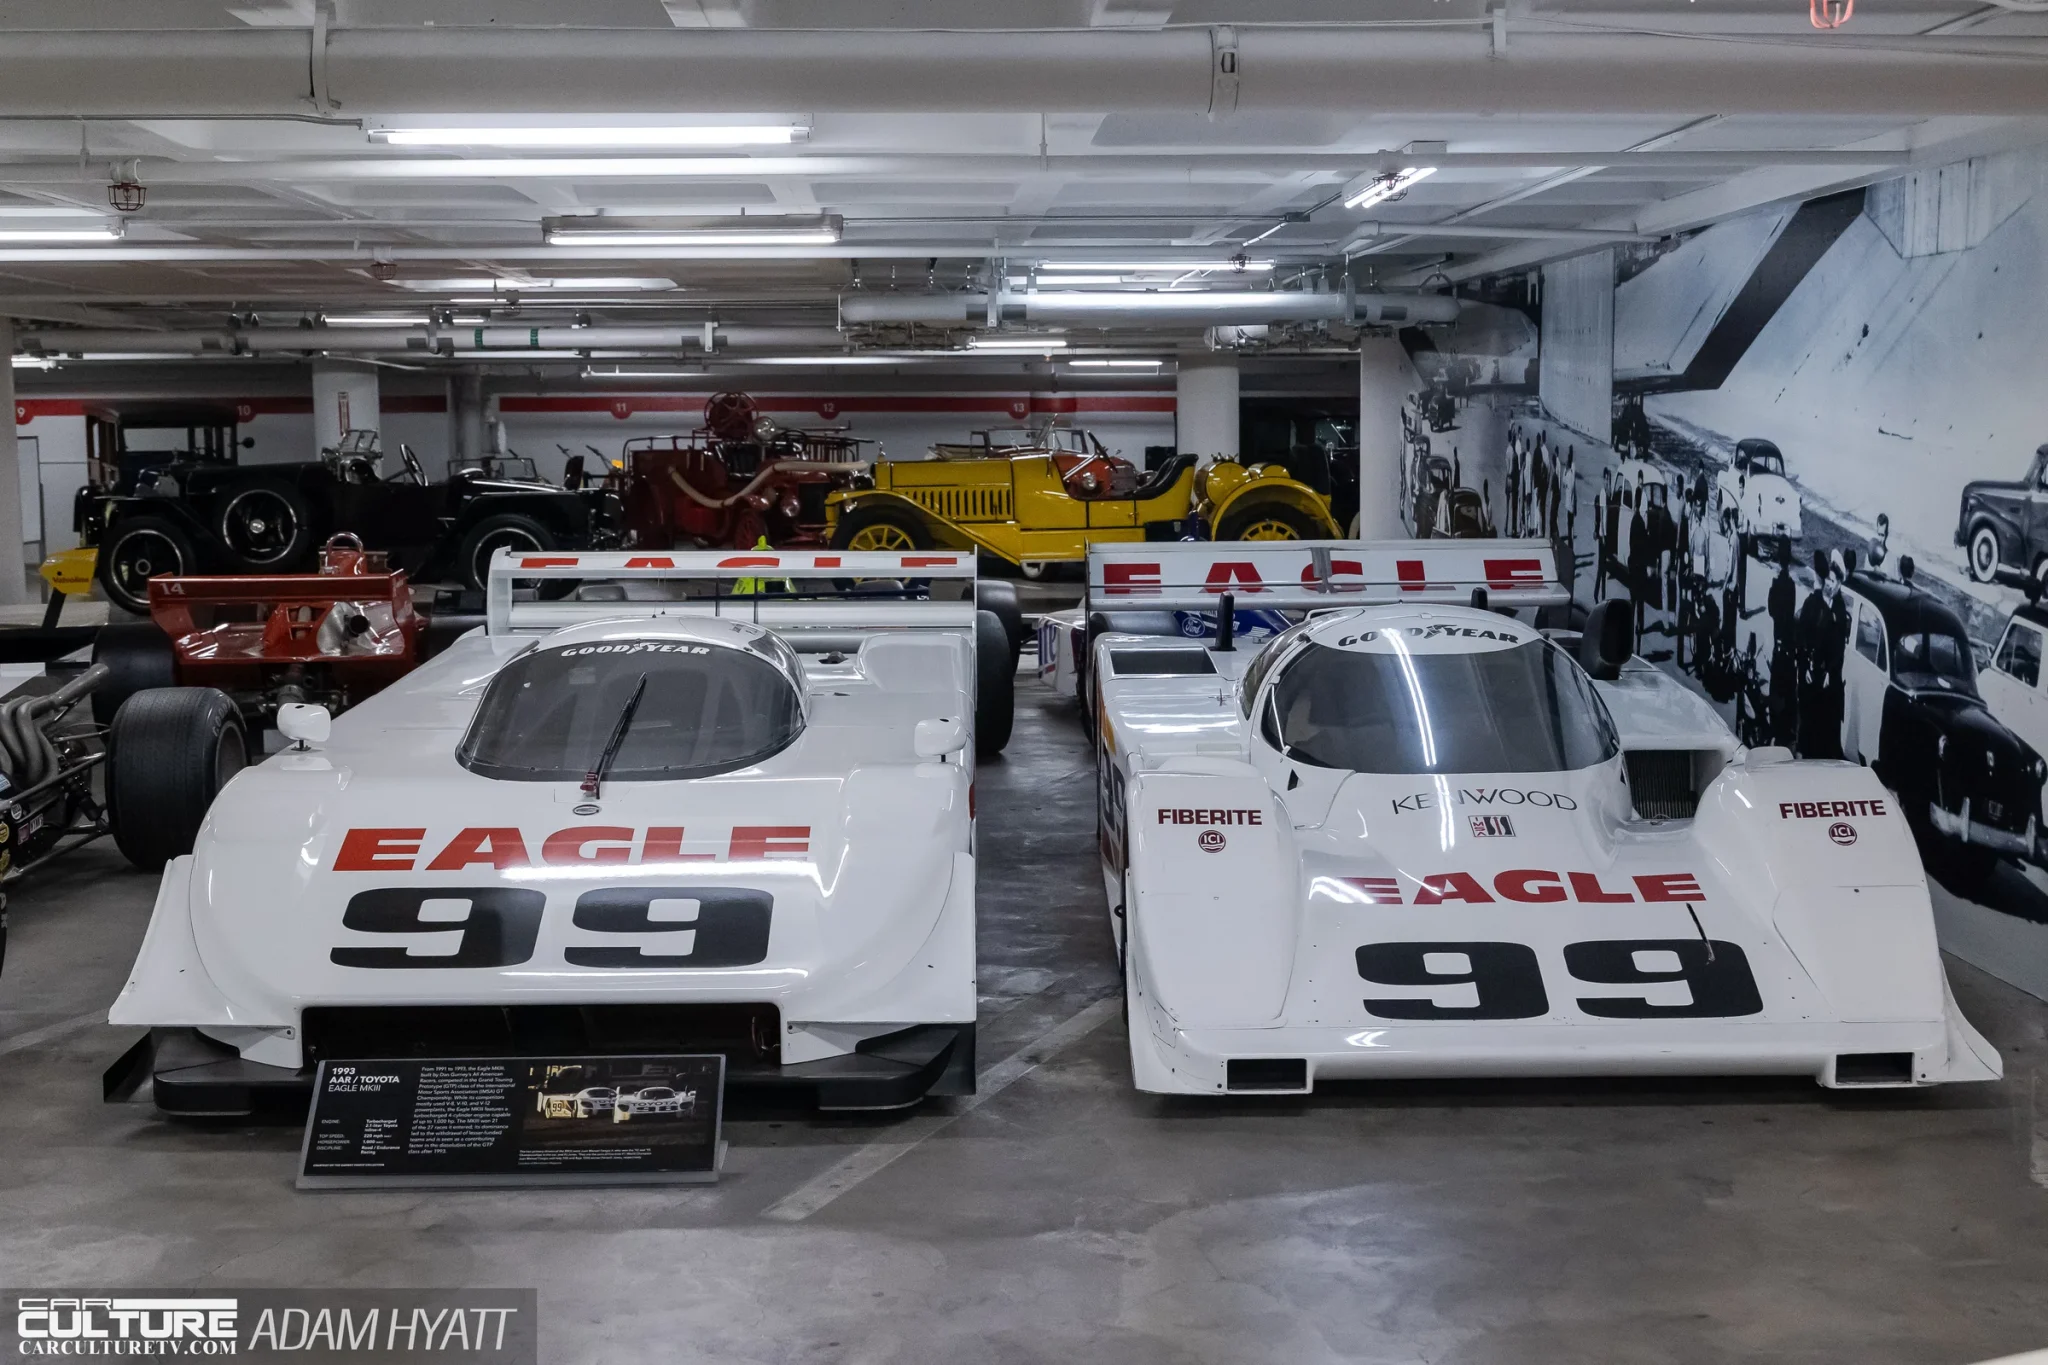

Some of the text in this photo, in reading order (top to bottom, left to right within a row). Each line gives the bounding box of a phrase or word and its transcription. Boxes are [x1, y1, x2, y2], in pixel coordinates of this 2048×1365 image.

[17, 407, 26, 418] 9
[238, 405, 251, 415] 10
[616, 403, 627, 412] 11
[823, 403, 835, 413] 12
[1012, 403, 1025, 413] 13
[160, 582, 185, 595] 14
[1185, 617, 1201, 634] Ford
[561, 641, 711, 657] GOODYEAR
[1779, 800, 1887, 819] FIBERITE
[1158, 809, 1262, 825] FIBERITE
[1833, 826, 1851, 836] ICI
[1203, 834, 1220, 844] ICI
[332, 826, 811, 871] EAGLE
[1338, 869, 1706, 905] EAGLE
[330, 886, 775, 969] 99
[1355, 938, 1764, 1020] 99
[332, 1067, 356, 1075] 1993
[329, 1076, 352, 1084] AAR
[352, 1076, 359, 1084] /
